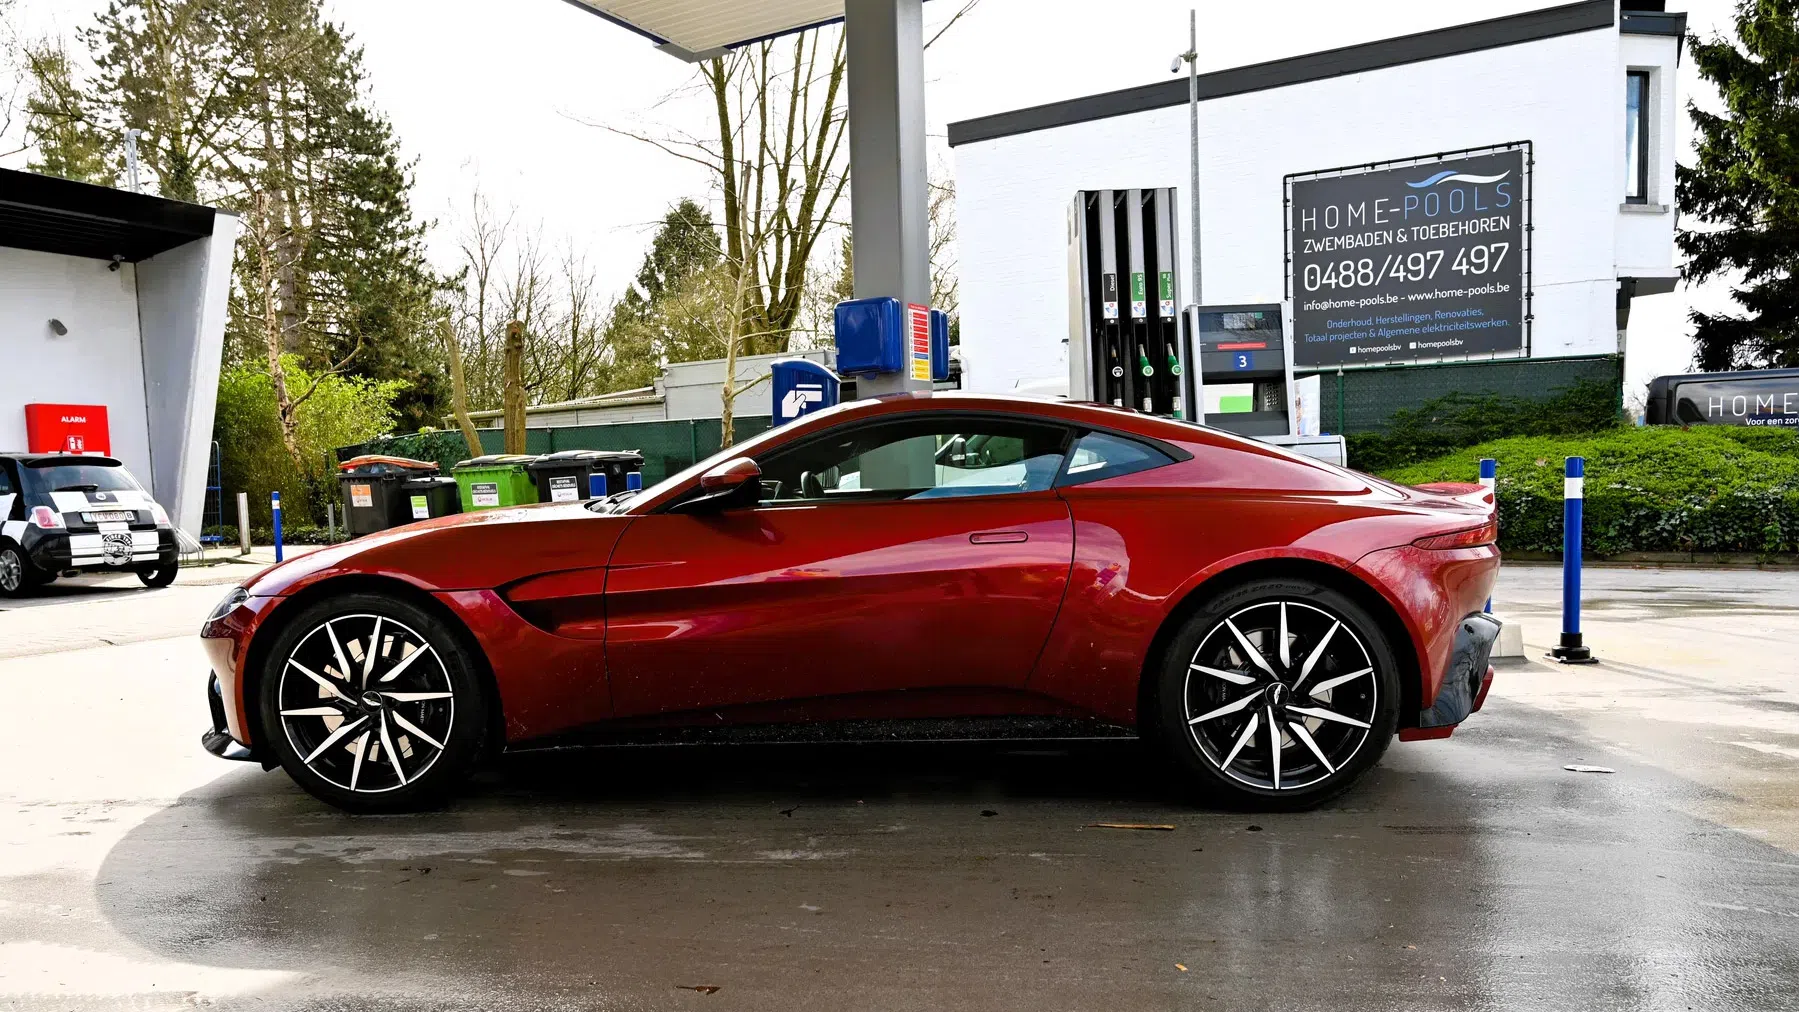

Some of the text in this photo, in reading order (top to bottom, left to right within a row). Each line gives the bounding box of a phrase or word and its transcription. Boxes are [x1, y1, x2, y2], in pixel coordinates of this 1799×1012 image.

[1302, 182, 1511, 232] HOME-POOLS
[1303, 215, 1510, 254] ZWEMBADEN & TOEBEHOREN
[1304, 242, 1510, 291] 0488/497 497
[1303, 294, 1399, 311] info@home-pools.be
[1407, 282, 1510, 302] www.home-pools.be
[1304, 317, 1510, 343] Totaal projecten & Algemene elektriciteitswerken.
[1357, 343, 1402, 354] homepoolsbv
[1417, 338, 1464, 349] homepoolsbv
[1238, 355, 1248, 368] 3
[1708, 393, 1799, 417] HOME
[1745, 418, 1765, 426] Voor
[1767, 416, 1783, 425] een
